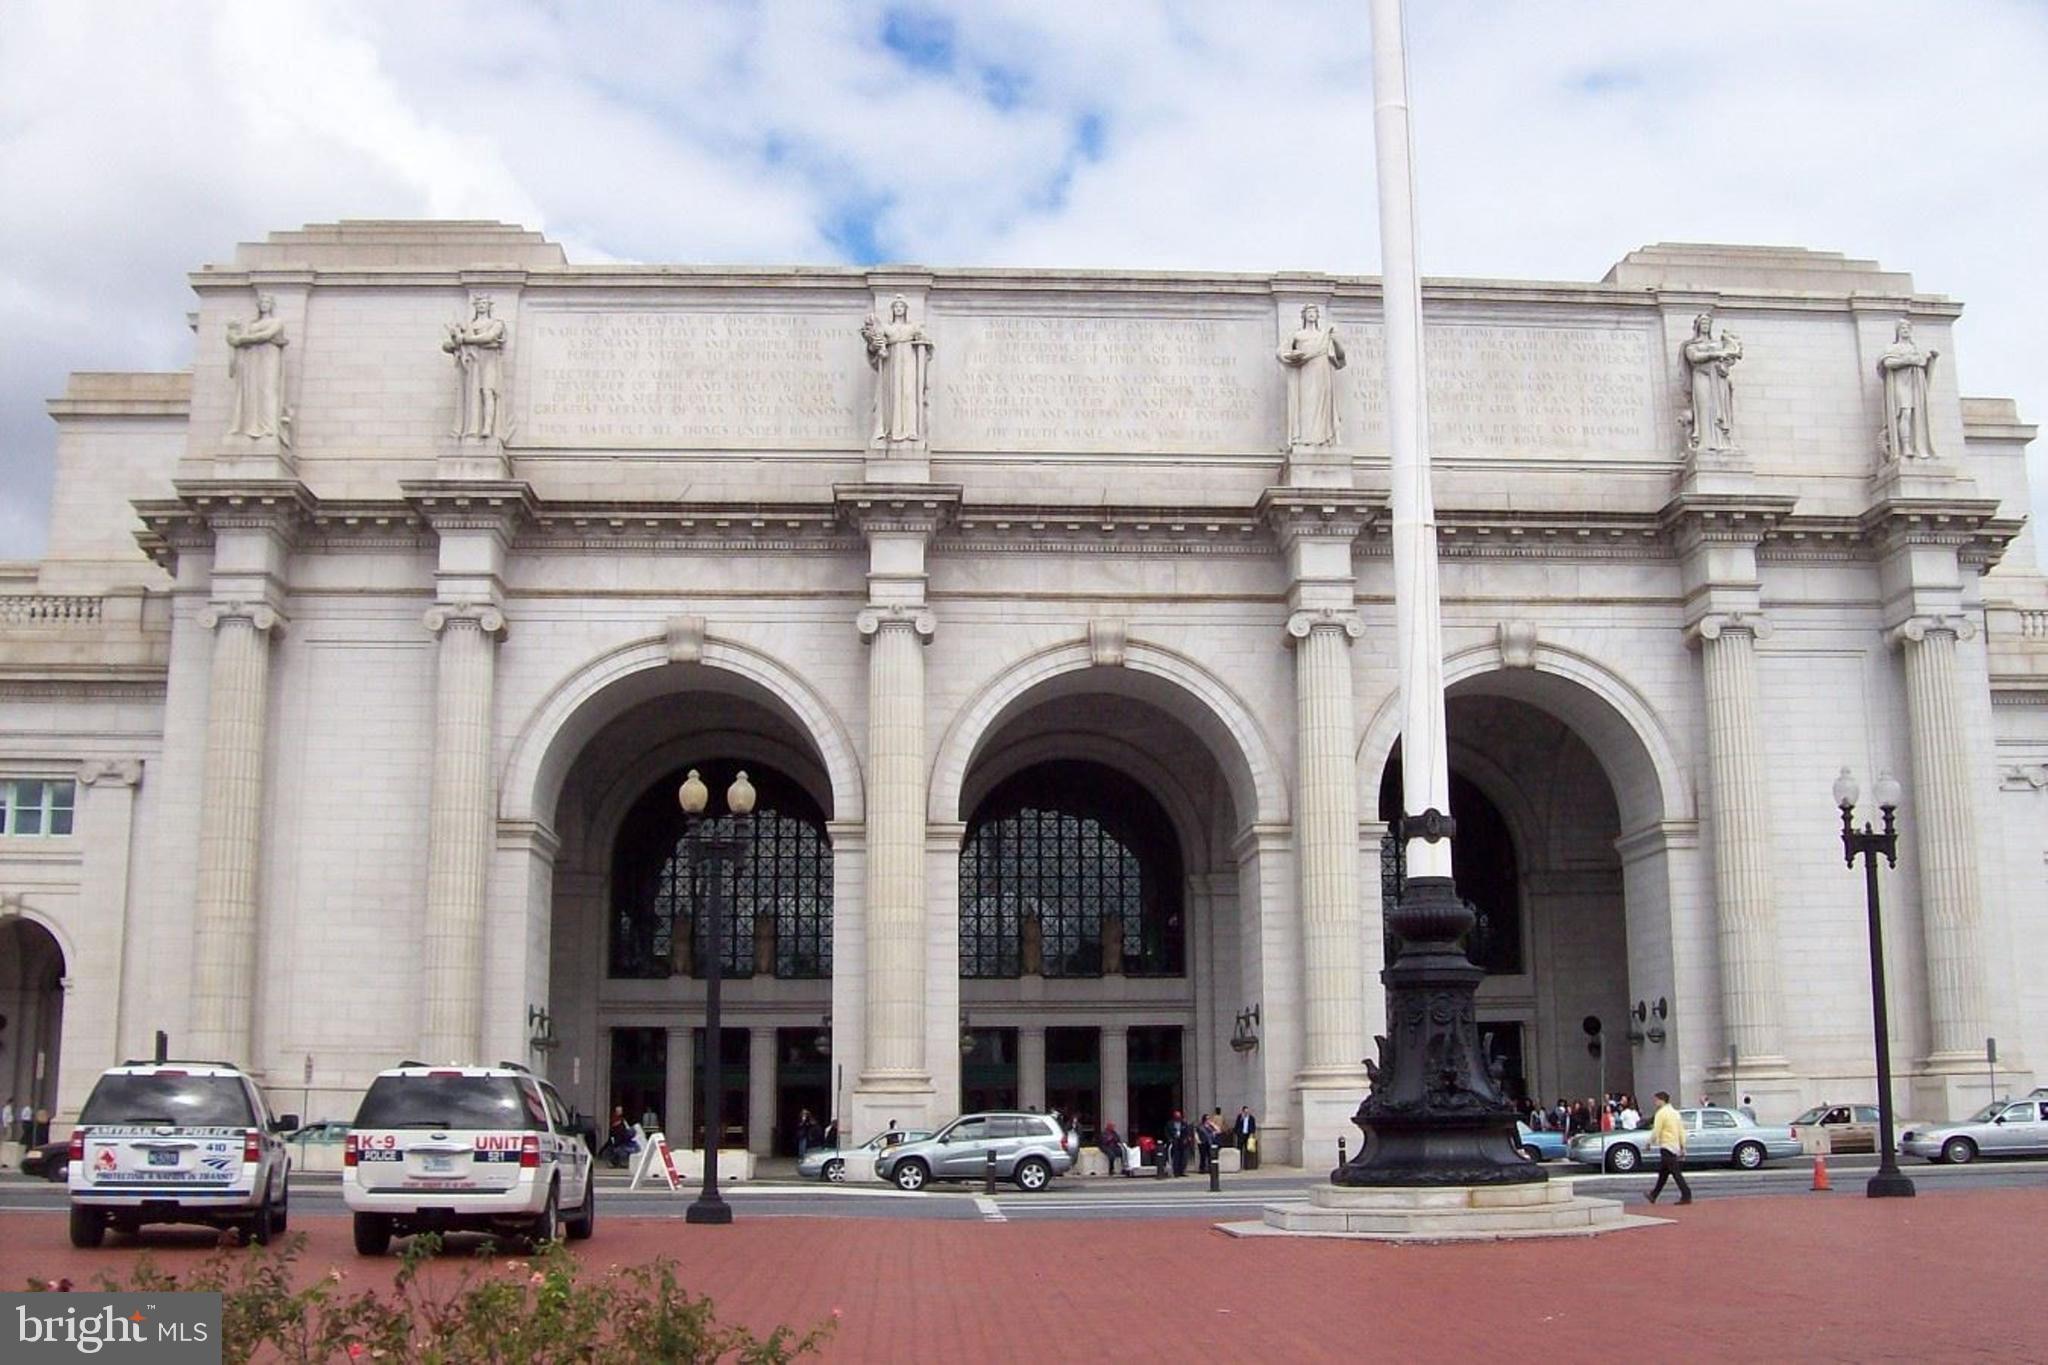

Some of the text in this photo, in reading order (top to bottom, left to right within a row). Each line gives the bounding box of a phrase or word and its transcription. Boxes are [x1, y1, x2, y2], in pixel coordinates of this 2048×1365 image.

[361, 1135, 520, 1149] K-9 UNIT
[364, 1150, 397, 1161] POLICE
